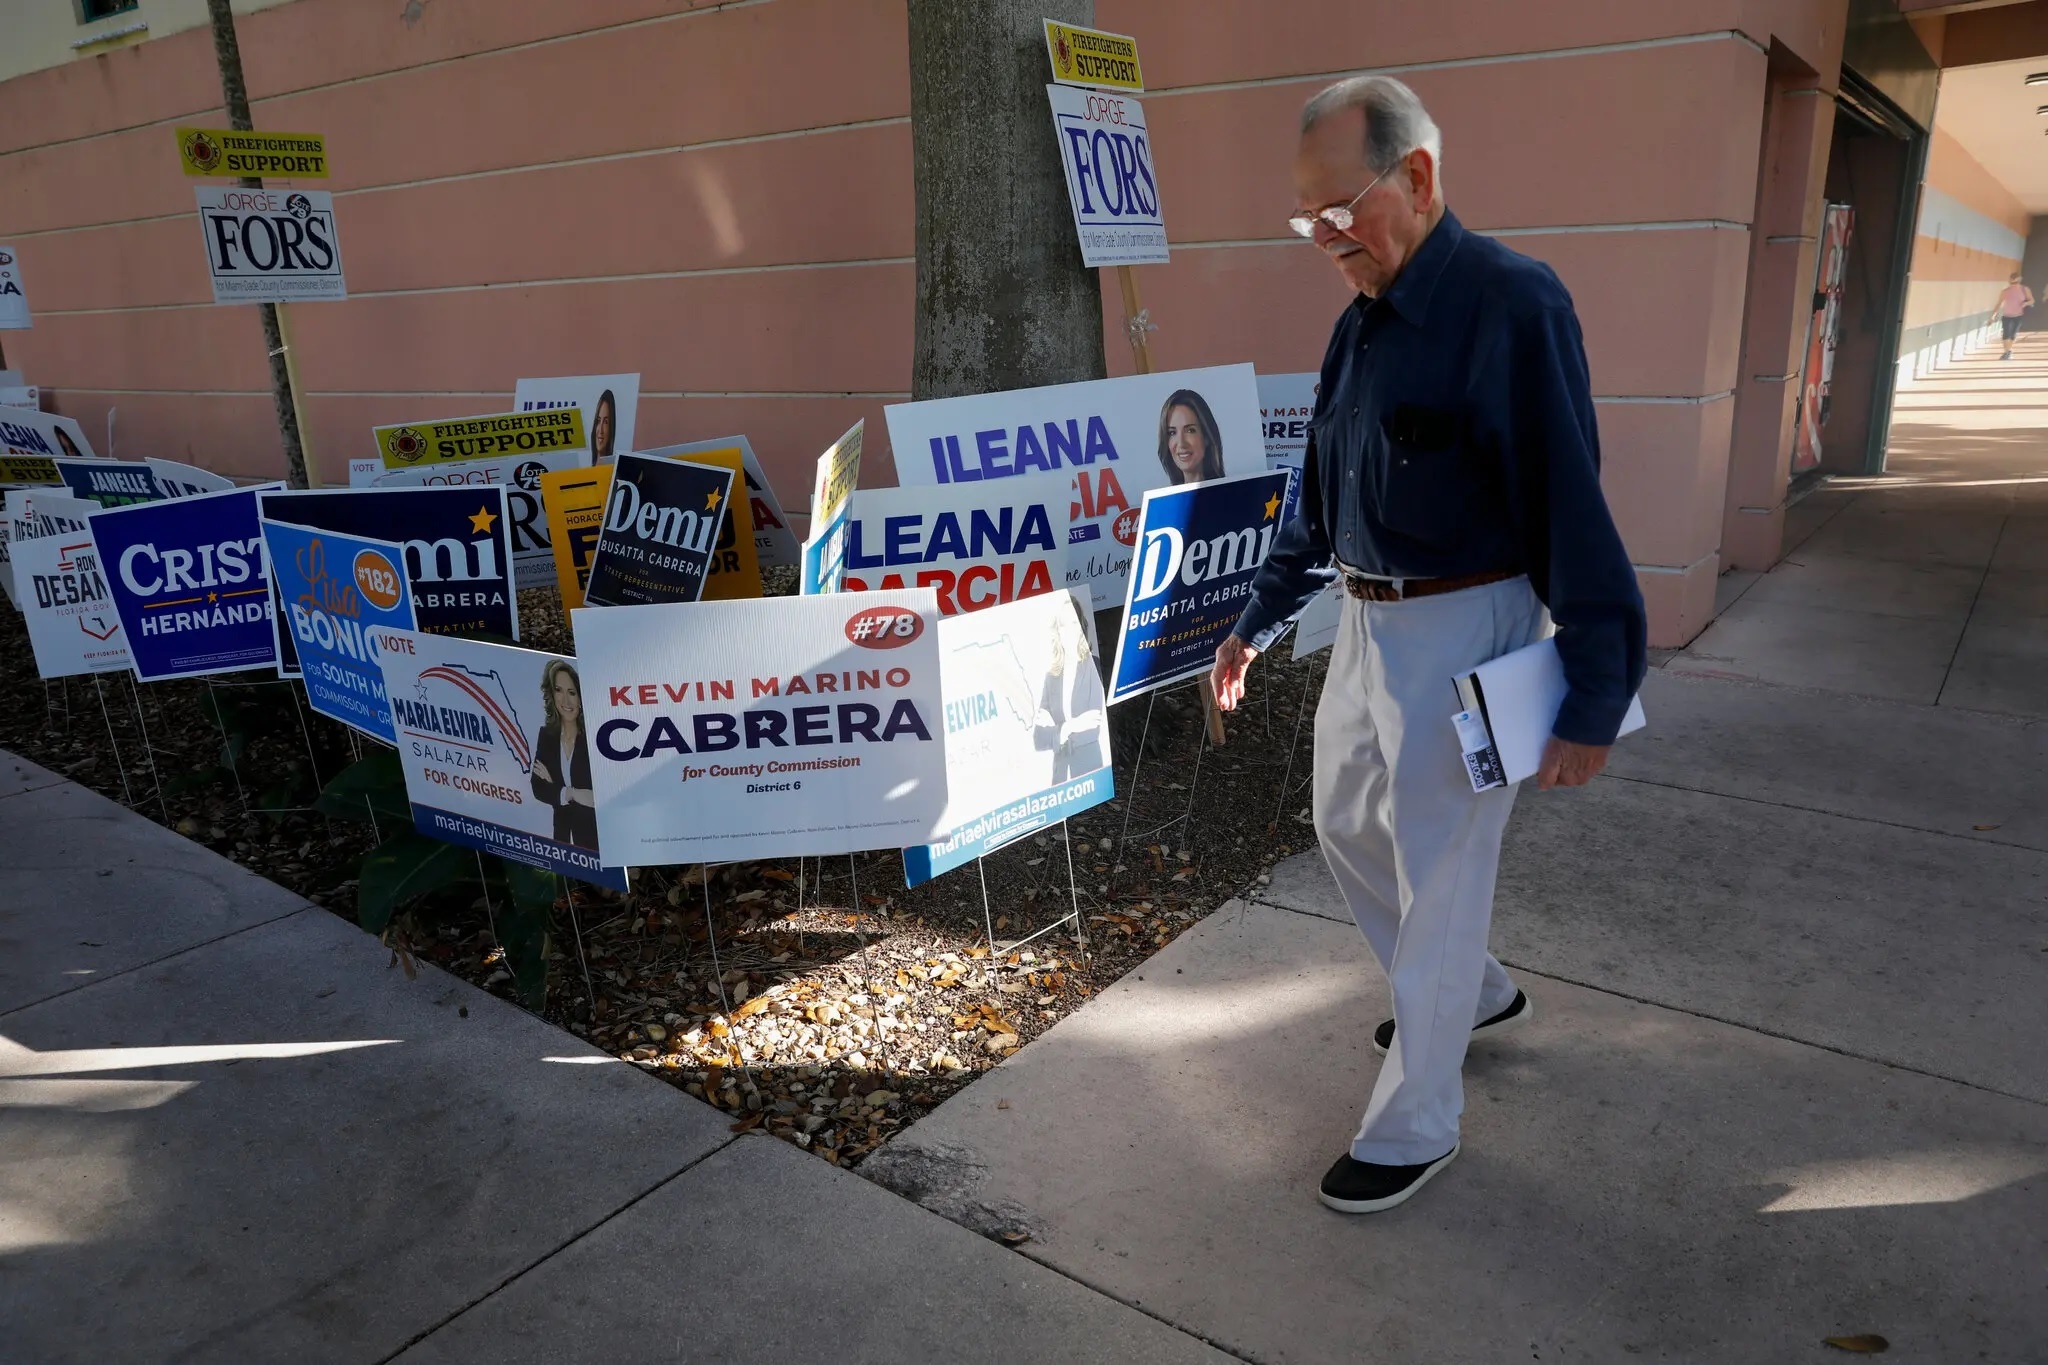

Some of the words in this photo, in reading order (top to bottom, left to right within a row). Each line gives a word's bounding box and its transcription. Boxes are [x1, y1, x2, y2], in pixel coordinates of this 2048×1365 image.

[1071, 32, 1133, 58] FIREFIGHTERS
[1076, 56, 1136, 82] SUPPORT
[1082, 95, 1128, 126] JORGE
[223, 137, 322, 152] FIREFIGHTERS
[228, 155, 323, 172] SUPPORT
[1065, 126, 1158, 218] FORS
[218, 193, 281, 212] JORGE
[209, 215, 334, 271] FORS
[433, 412, 571, 438] FIREFIGHTERS
[1274, 408, 1314, 417] MARI
[437, 428, 575, 458] SUPPORT
[929, 416, 1119, 485] ILEANA
[88, 471, 151, 494] JANELLE
[353, 463, 375, 472] VOTE
[566, 513, 603, 525] HORACE
[606, 479, 714, 554] Demi
[847, 504, 1056, 570] LEANA
[1068, 529, 1086, 540] ATE
[76, 555, 97, 572] RON
[119, 536, 268, 597] CRIST
[403, 537, 503, 582] mi
[514, 562, 557, 574] mmissione
[600, 539, 645, 561] BUSATTA
[649, 553, 701, 577] CABRERA
[1133, 522, 1274, 602] Demi
[32, 571, 110, 609] DESAN
[296, 538, 361, 620] Lisa
[357, 566, 396, 595] #182
[842, 559, 1055, 617] RCIA
[414, 591, 506, 609] ABRERA
[1128, 597, 1195, 631] BUSATTA
[1202, 580, 1252, 608] CABRE
[141, 602, 273, 636] HERNÁNDE
[423, 619, 487, 635] NTATIVE
[852, 614, 915, 640] #78
[1138, 637, 1167, 650] STATE
[1171, 611, 1242, 643] REPRESENTATI
[1192, 616, 1204, 624] FOR
[379, 635, 416, 655] VOTE
[1171, 641, 1201, 657] DISTRICT
[306, 662, 322, 677] FOR
[321, 661, 370, 697] SOUTH
[609, 680, 735, 706] KEVIN
[752, 667, 911, 698] MARINO
[314, 683, 370, 717] COMMISSION
[945, 690, 998, 734] ELVIRA
[392, 697, 442, 737] MARIA
[440, 707, 494, 745] ELVIRA
[596, 699, 933, 762] CABRERA
[412, 742, 489, 773] SALAZAR
[682, 765, 706, 782] for
[709, 761, 764, 779] County
[767, 756, 861, 774] Commission
[424, 768, 450, 787] FOR
[452, 775, 523, 805] CONGRESS
[746, 781, 791, 794] District
[793, 780, 802, 791] 6
[930, 777, 1096, 860] mariaelvirasalazar.com
[435, 813, 604, 873] mariaelvirasalazar.com
